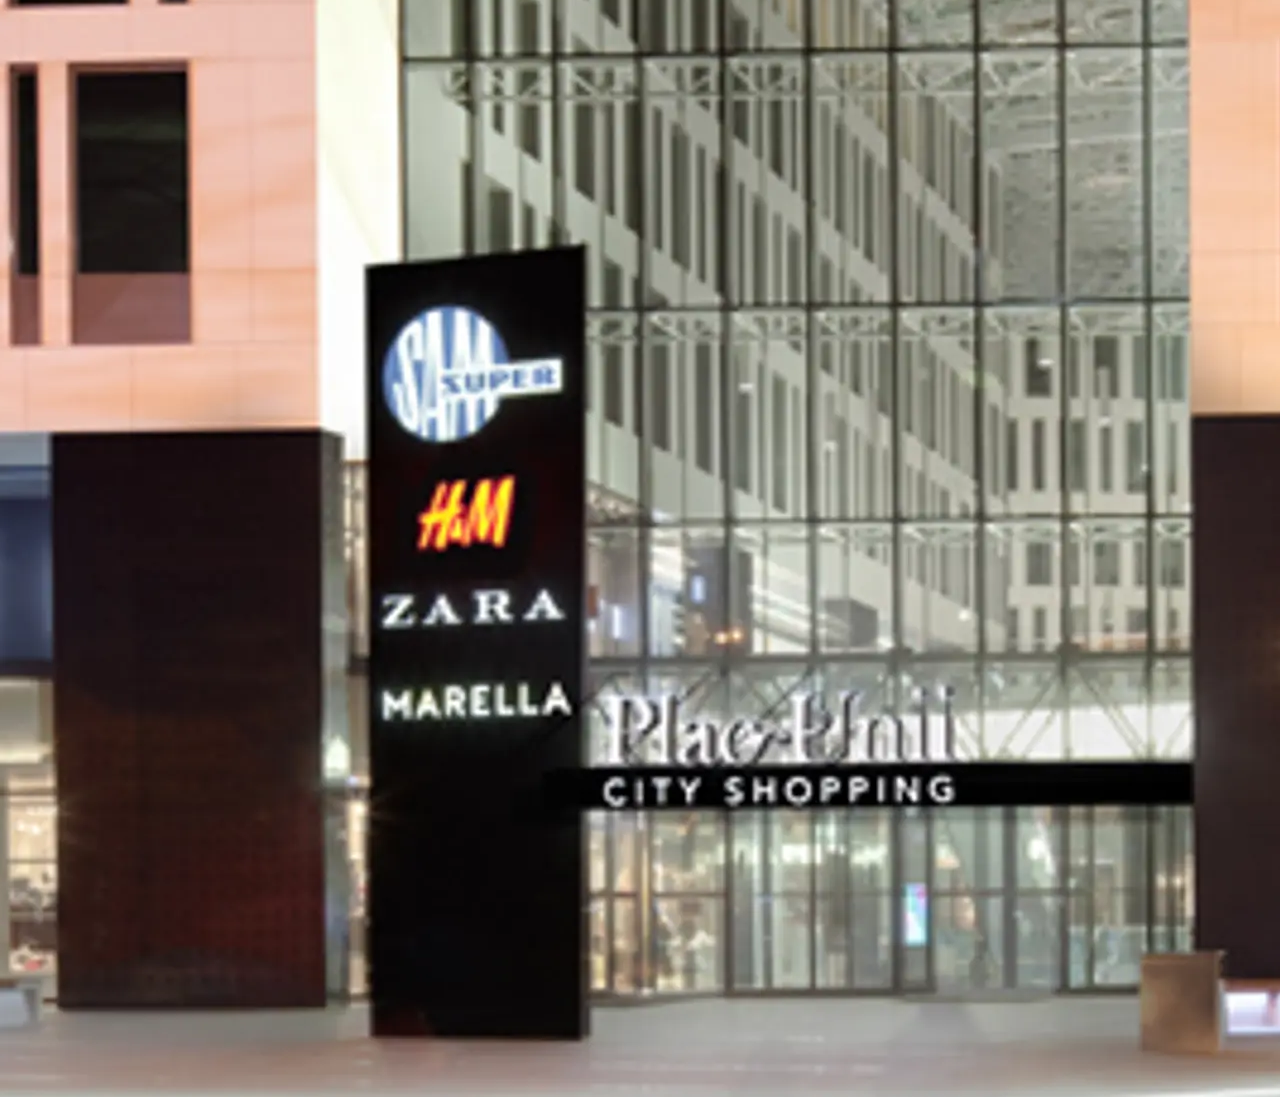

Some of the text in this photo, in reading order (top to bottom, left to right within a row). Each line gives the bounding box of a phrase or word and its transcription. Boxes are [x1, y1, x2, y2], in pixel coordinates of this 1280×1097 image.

[440, 365, 556, 393] SUPER
[417, 474, 515, 550] H&M
[381, 588, 566, 629] ZARA
[381, 682, 573, 721] MARELLA
[602, 774, 956, 808] CITY SHOPPING
